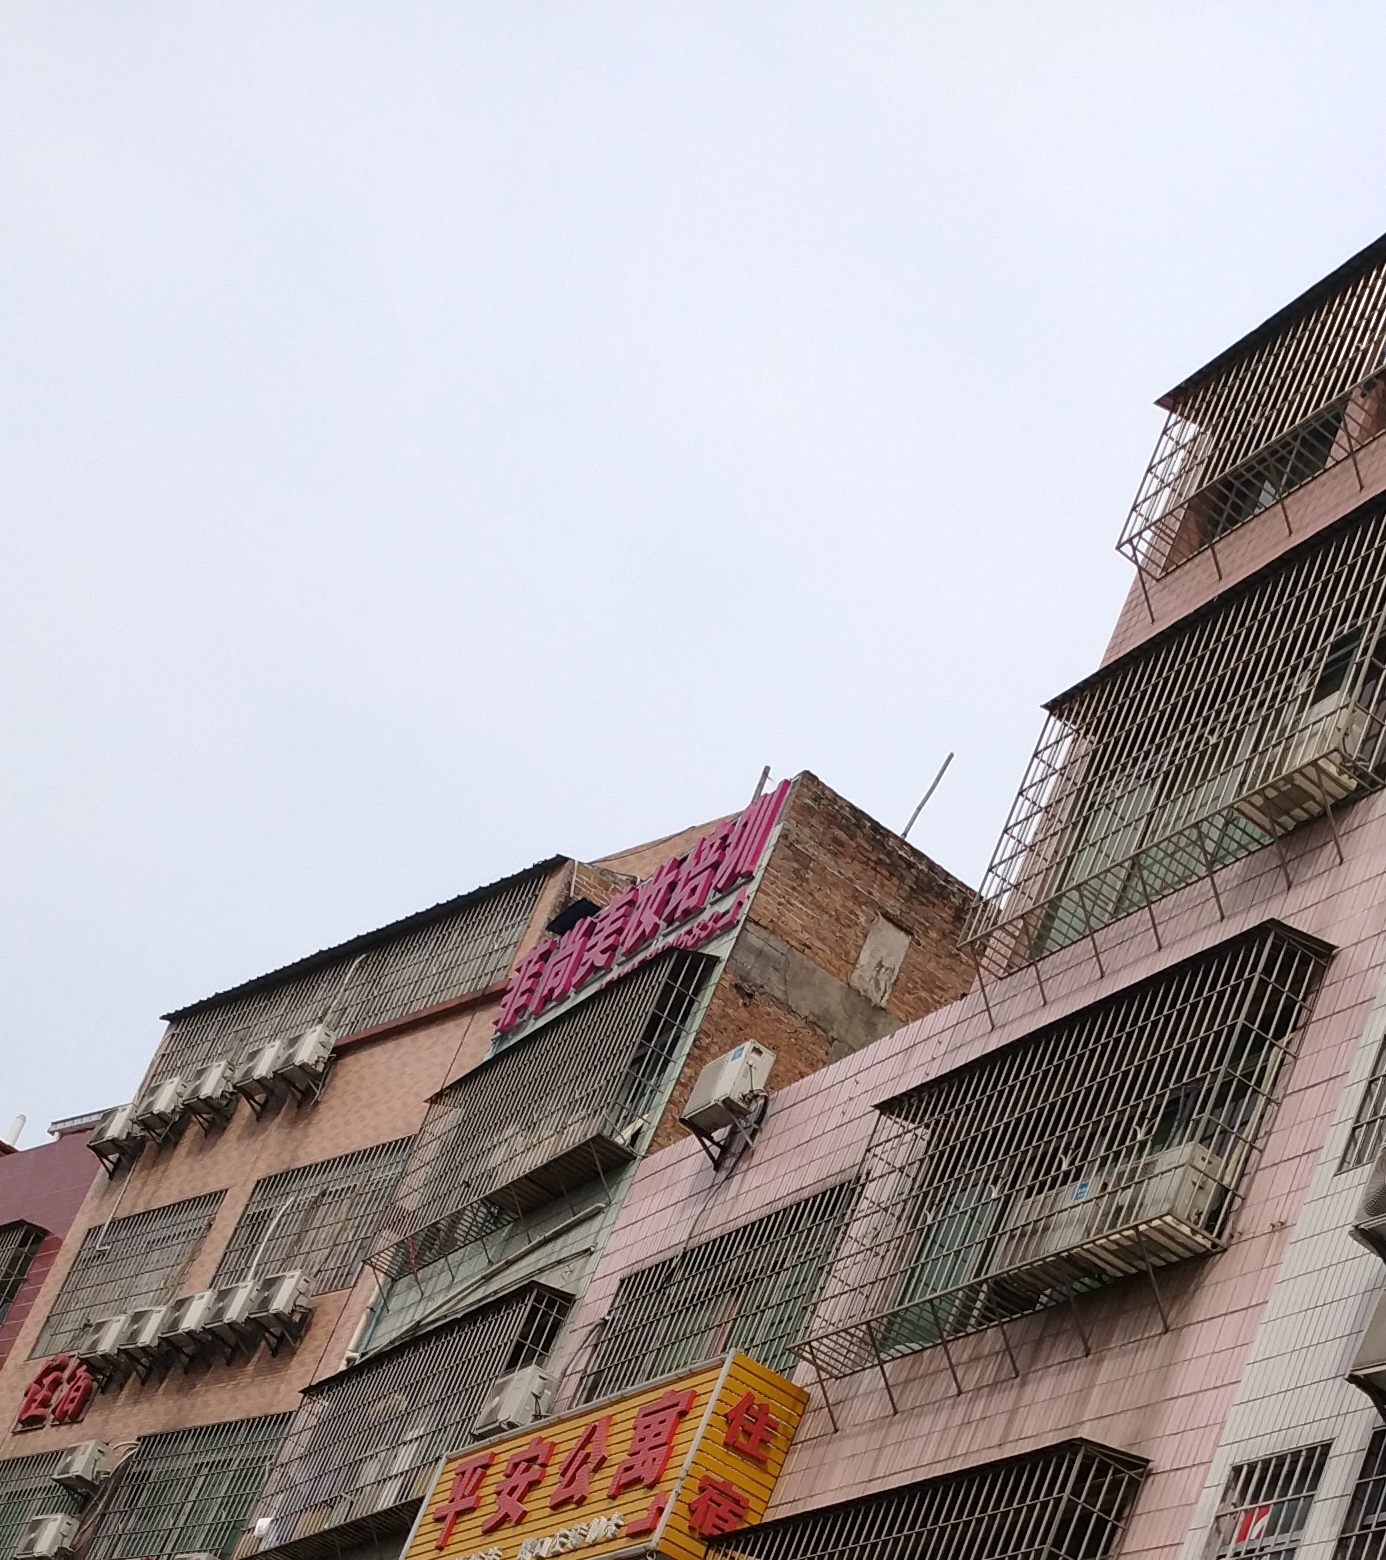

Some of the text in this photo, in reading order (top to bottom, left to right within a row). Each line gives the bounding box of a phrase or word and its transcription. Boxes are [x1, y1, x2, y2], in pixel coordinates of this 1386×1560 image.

[433, 1388, 698, 1550] 平安公寓
[687, 1390, 780, 1537] 住宿
